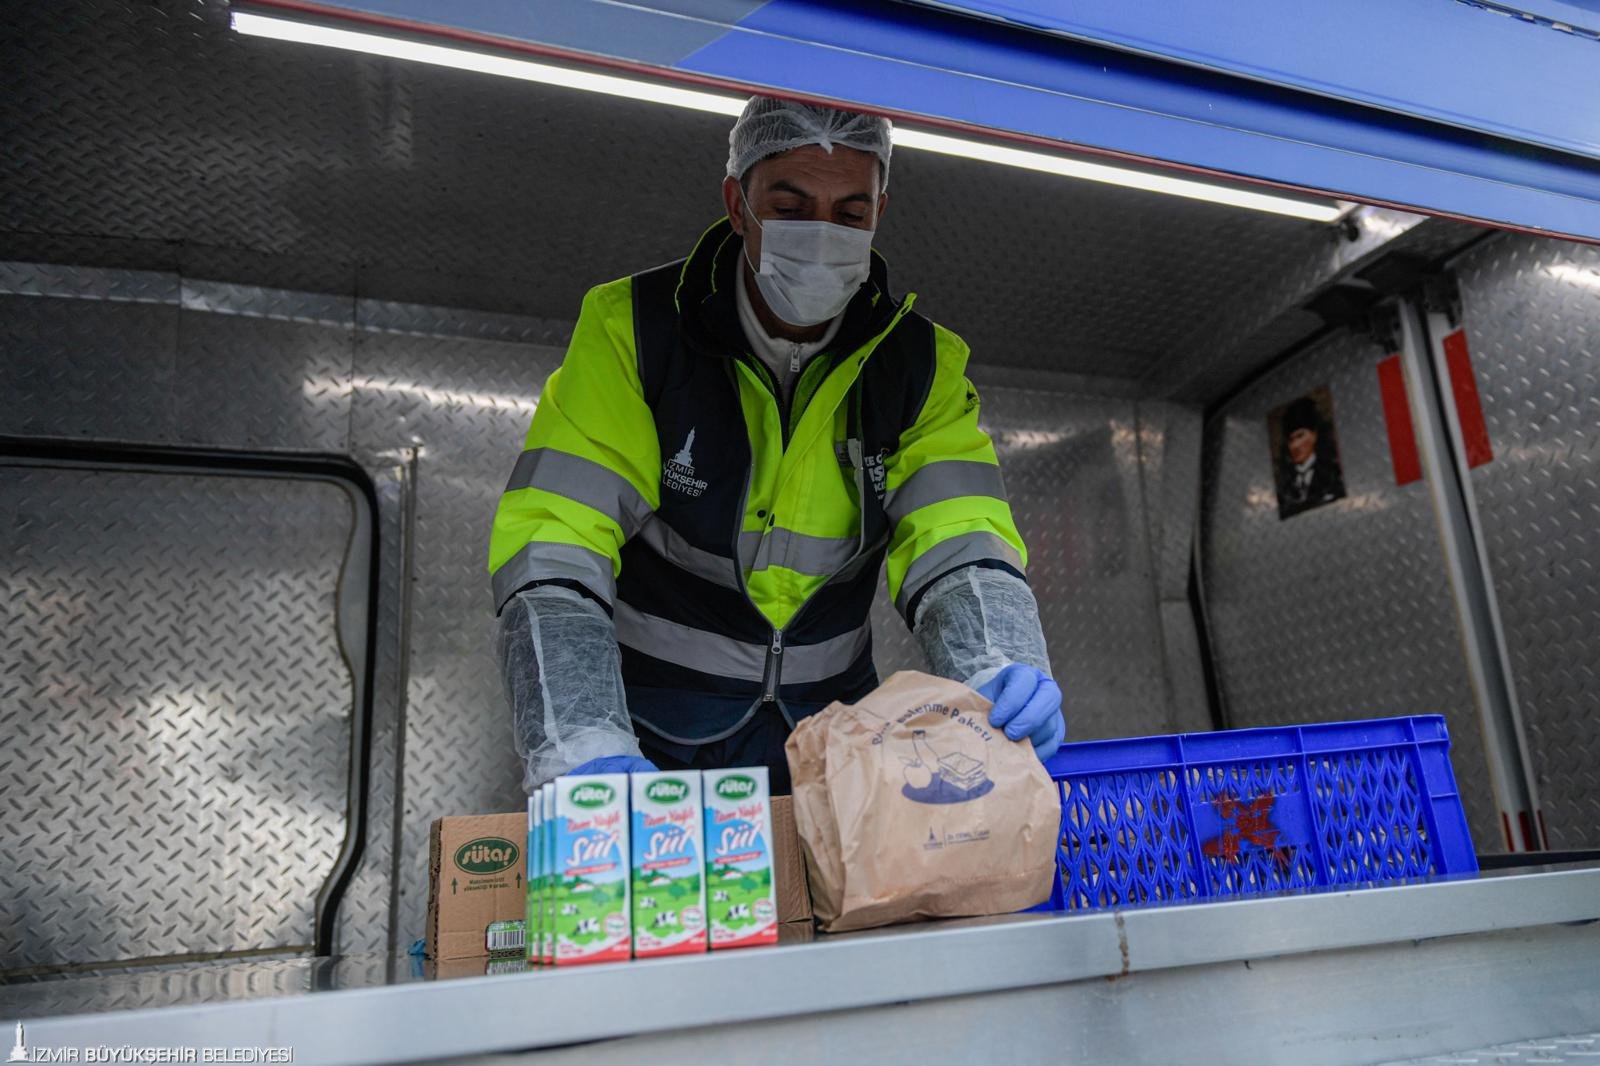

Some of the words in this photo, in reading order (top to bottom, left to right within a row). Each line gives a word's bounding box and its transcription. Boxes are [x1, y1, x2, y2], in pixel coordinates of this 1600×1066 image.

[566, 830, 620, 866] Süt
[643, 825, 693, 860] Süt
[715, 820, 763, 855] Süt
